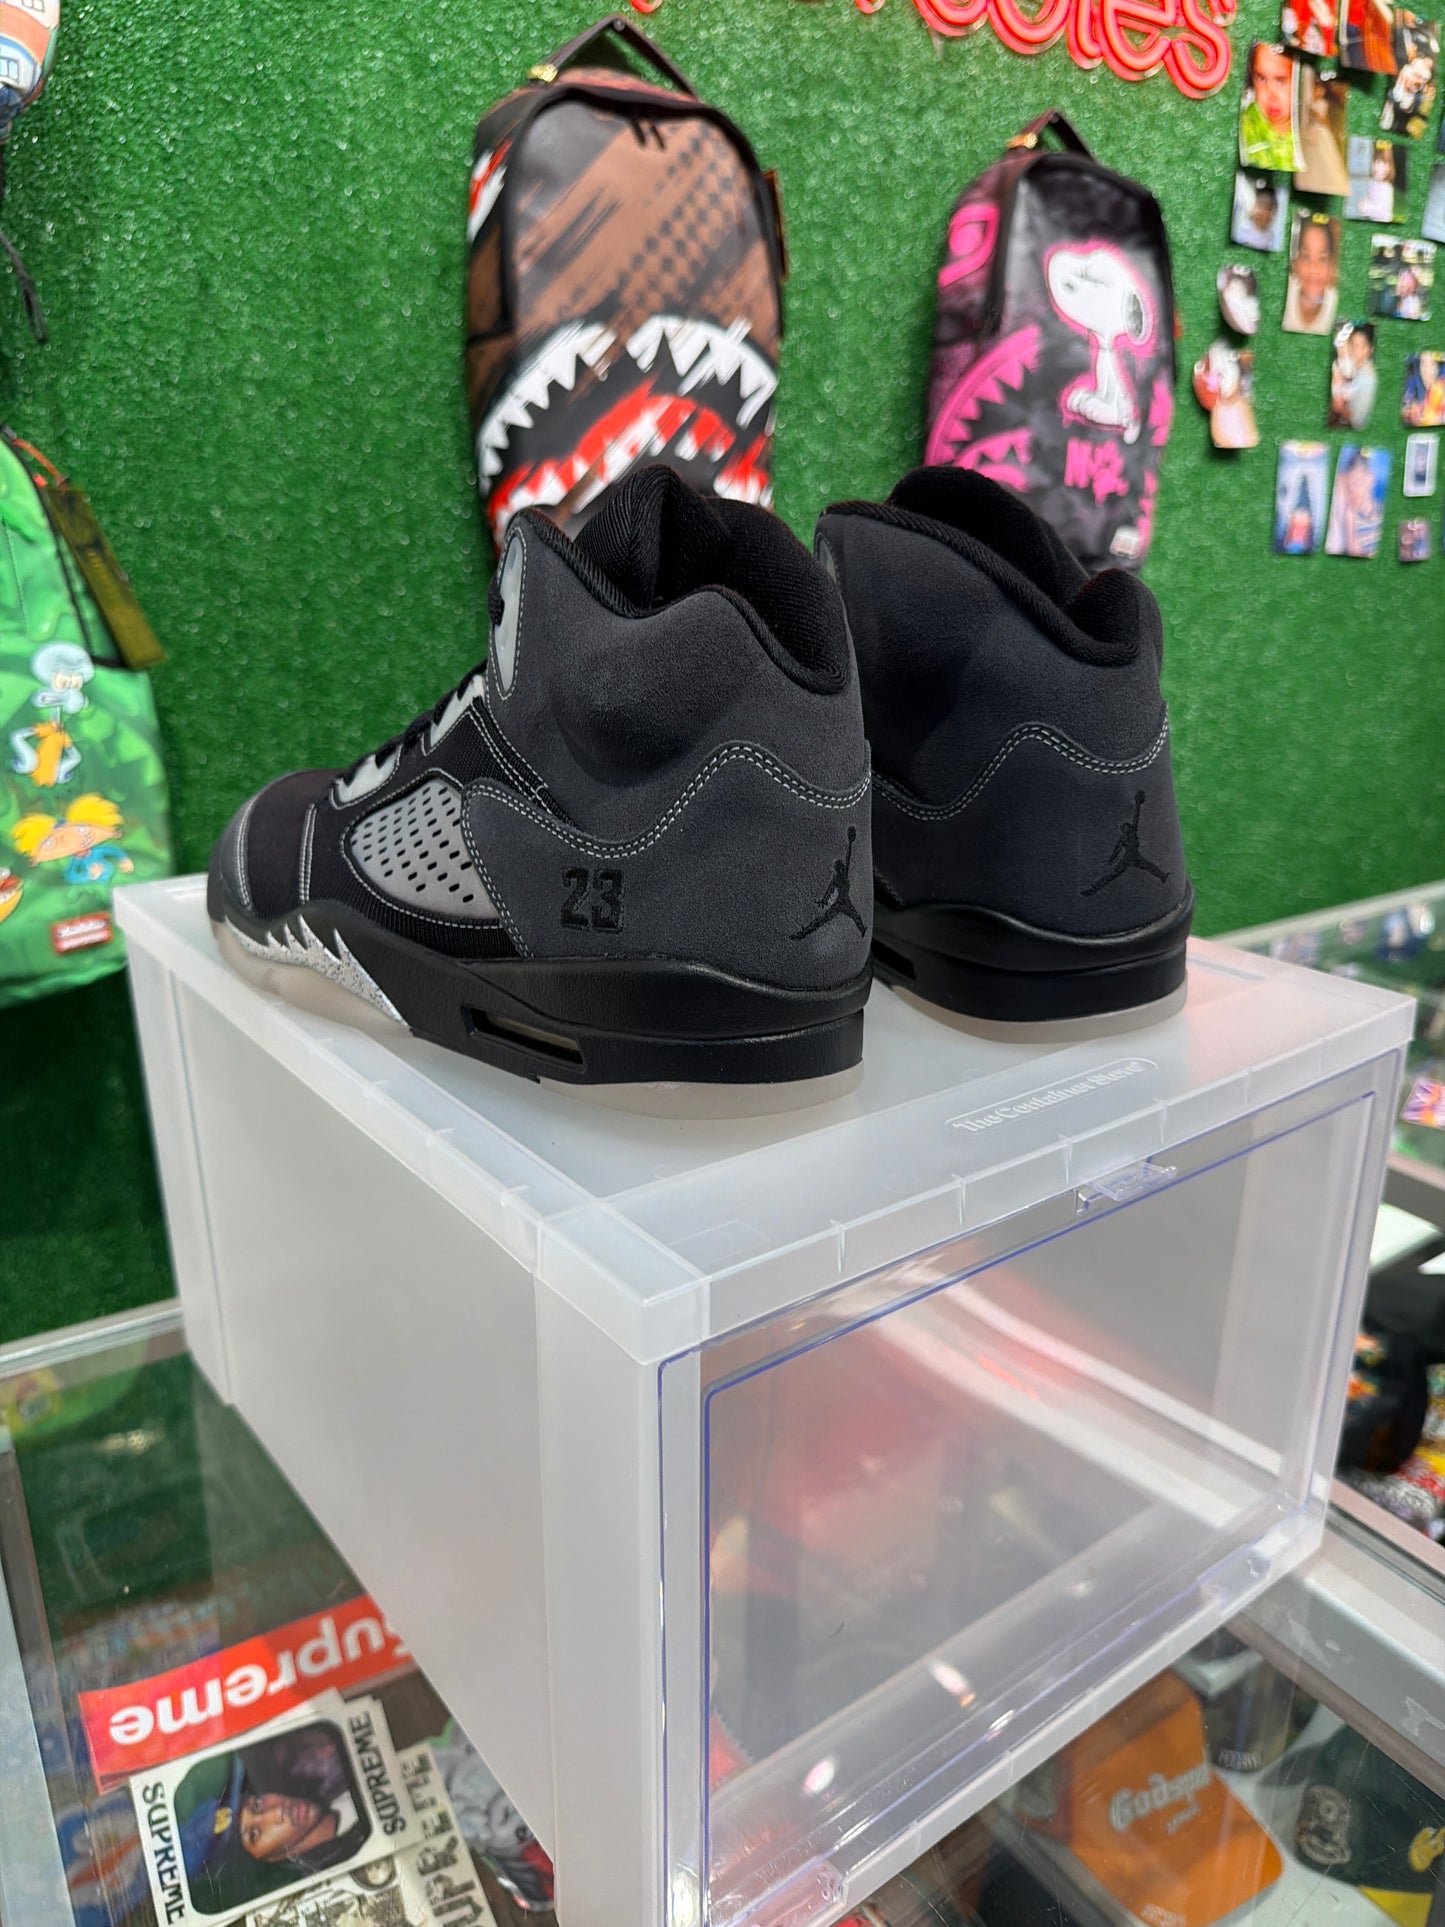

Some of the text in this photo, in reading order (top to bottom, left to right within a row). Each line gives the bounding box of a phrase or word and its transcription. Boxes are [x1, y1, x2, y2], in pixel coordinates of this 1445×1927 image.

[560, 866, 624, 934] 23
[953, 1112, 1002, 1132] The
[995, 1082, 1096, 1119] Container
[350, 1710, 406, 1836] SUPREME
[142, 1781, 187, 1925] SUPREME
